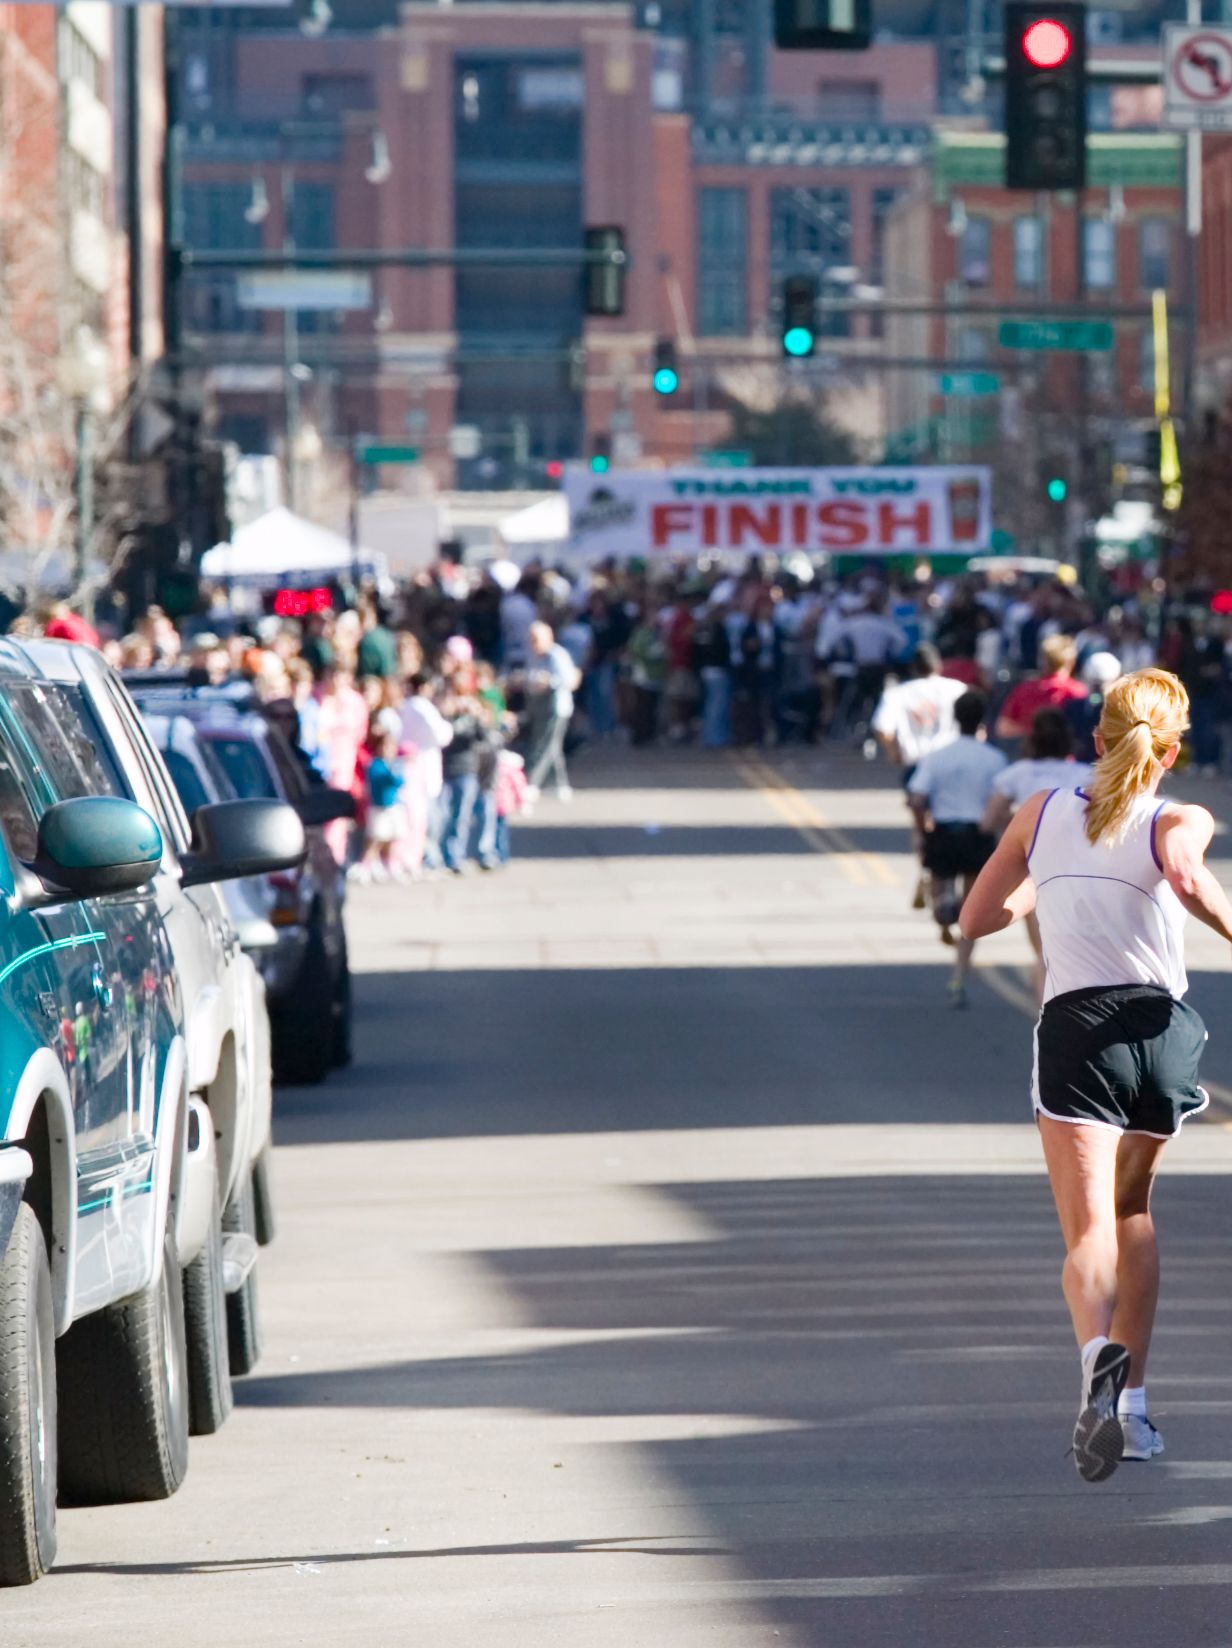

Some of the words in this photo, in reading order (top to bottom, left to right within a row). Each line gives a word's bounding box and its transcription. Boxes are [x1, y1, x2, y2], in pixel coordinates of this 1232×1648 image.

[672, 478, 809, 496] THANK
[833, 478, 915, 495] YOU
[651, 502, 931, 547] FINISH
